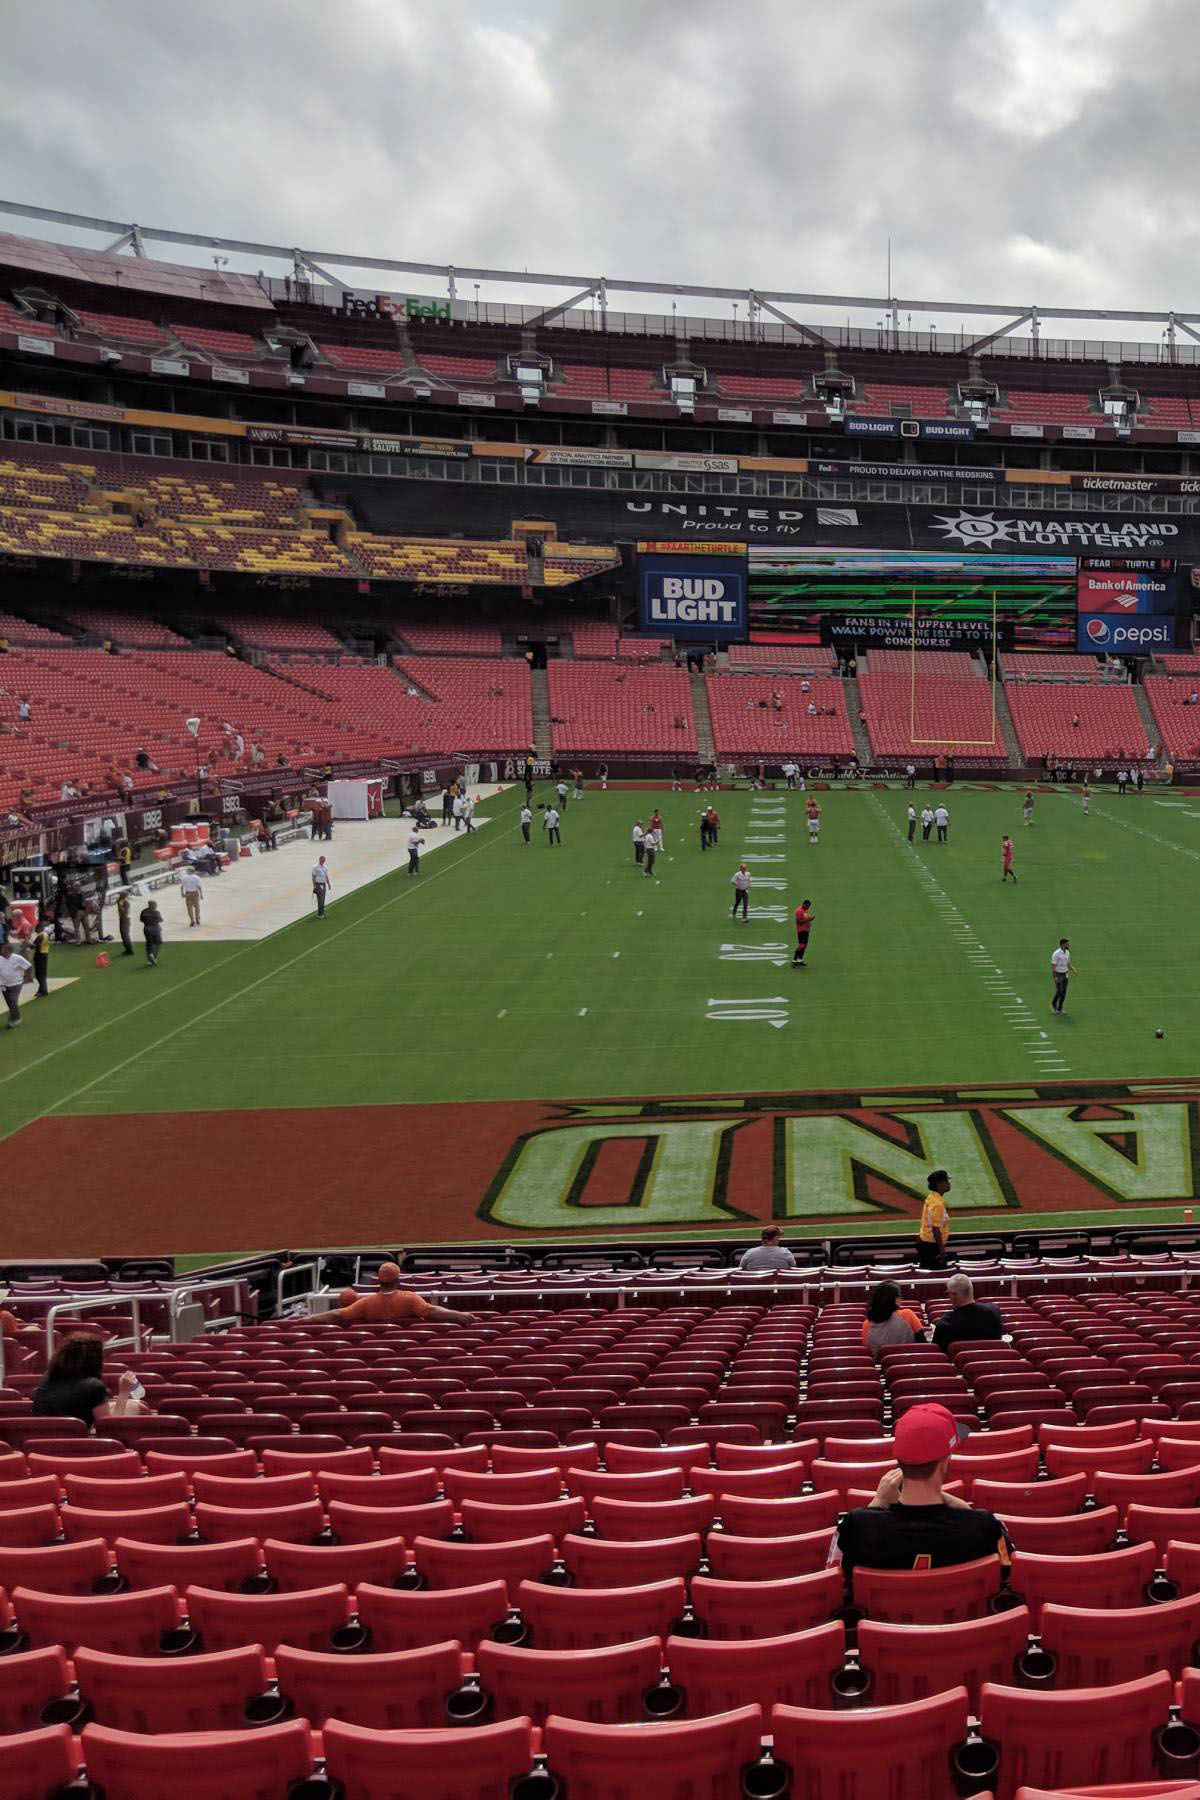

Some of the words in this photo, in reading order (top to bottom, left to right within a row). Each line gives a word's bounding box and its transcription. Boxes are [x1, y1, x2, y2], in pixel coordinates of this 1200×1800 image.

[342, 291, 451, 320] FedExField
[850, 423, 868, 431] BUD
[869, 424, 895, 432] LIGHT
[926, 426, 944, 434] BUD
[945, 427, 970, 435] LIGHT
[372, 445, 401, 453] SALUTE
[711, 461, 730, 470] sas
[850, 466, 877, 475] PROUD
[890, 468, 921, 477] DELIVER
[939, 470, 954, 478] THE
[1083, 477, 1153, 491] ticketmaster
[627, 502, 804, 520] UNITED
[682, 520, 741, 531] Proud
[749, 524, 769, 532] to
[776, 525, 800, 534] fly
[1016, 520, 1179, 536] MARYLAND
[1019, 532, 1151, 548] LOTTERY
[663, 577, 725, 600] BUD
[1088, 579, 1114, 590] Bank
[1114, 580, 1125, 590] of
[1125, 580, 1166, 591] America
[651, 598, 737, 621] LIGHT
[845, 618, 874, 627] FANS
[879, 619, 891, 627] IN
[895, 620, 913, 628] THE
[918, 620, 952, 629] UPPER
[957, 621, 990, 630] LEVEL
[832, 626, 866, 636] WALK
[869, 627, 906, 637] DOWN
[910, 629, 929, 638] THE
[933, 630, 962, 639] ISLES
[966, 631, 980, 639] TO
[983, 632, 1003, 640] THE
[1114, 625, 1168, 645] pepsi
[885, 637, 951, 647] CONCOURSE
[423, 770, 437, 784] 1991
[856, 769, 909, 780] Foundation
[222, 795, 241, 813] 1983
[143, 810, 162, 831] 1982
[705, 996, 789, 1020] 10
